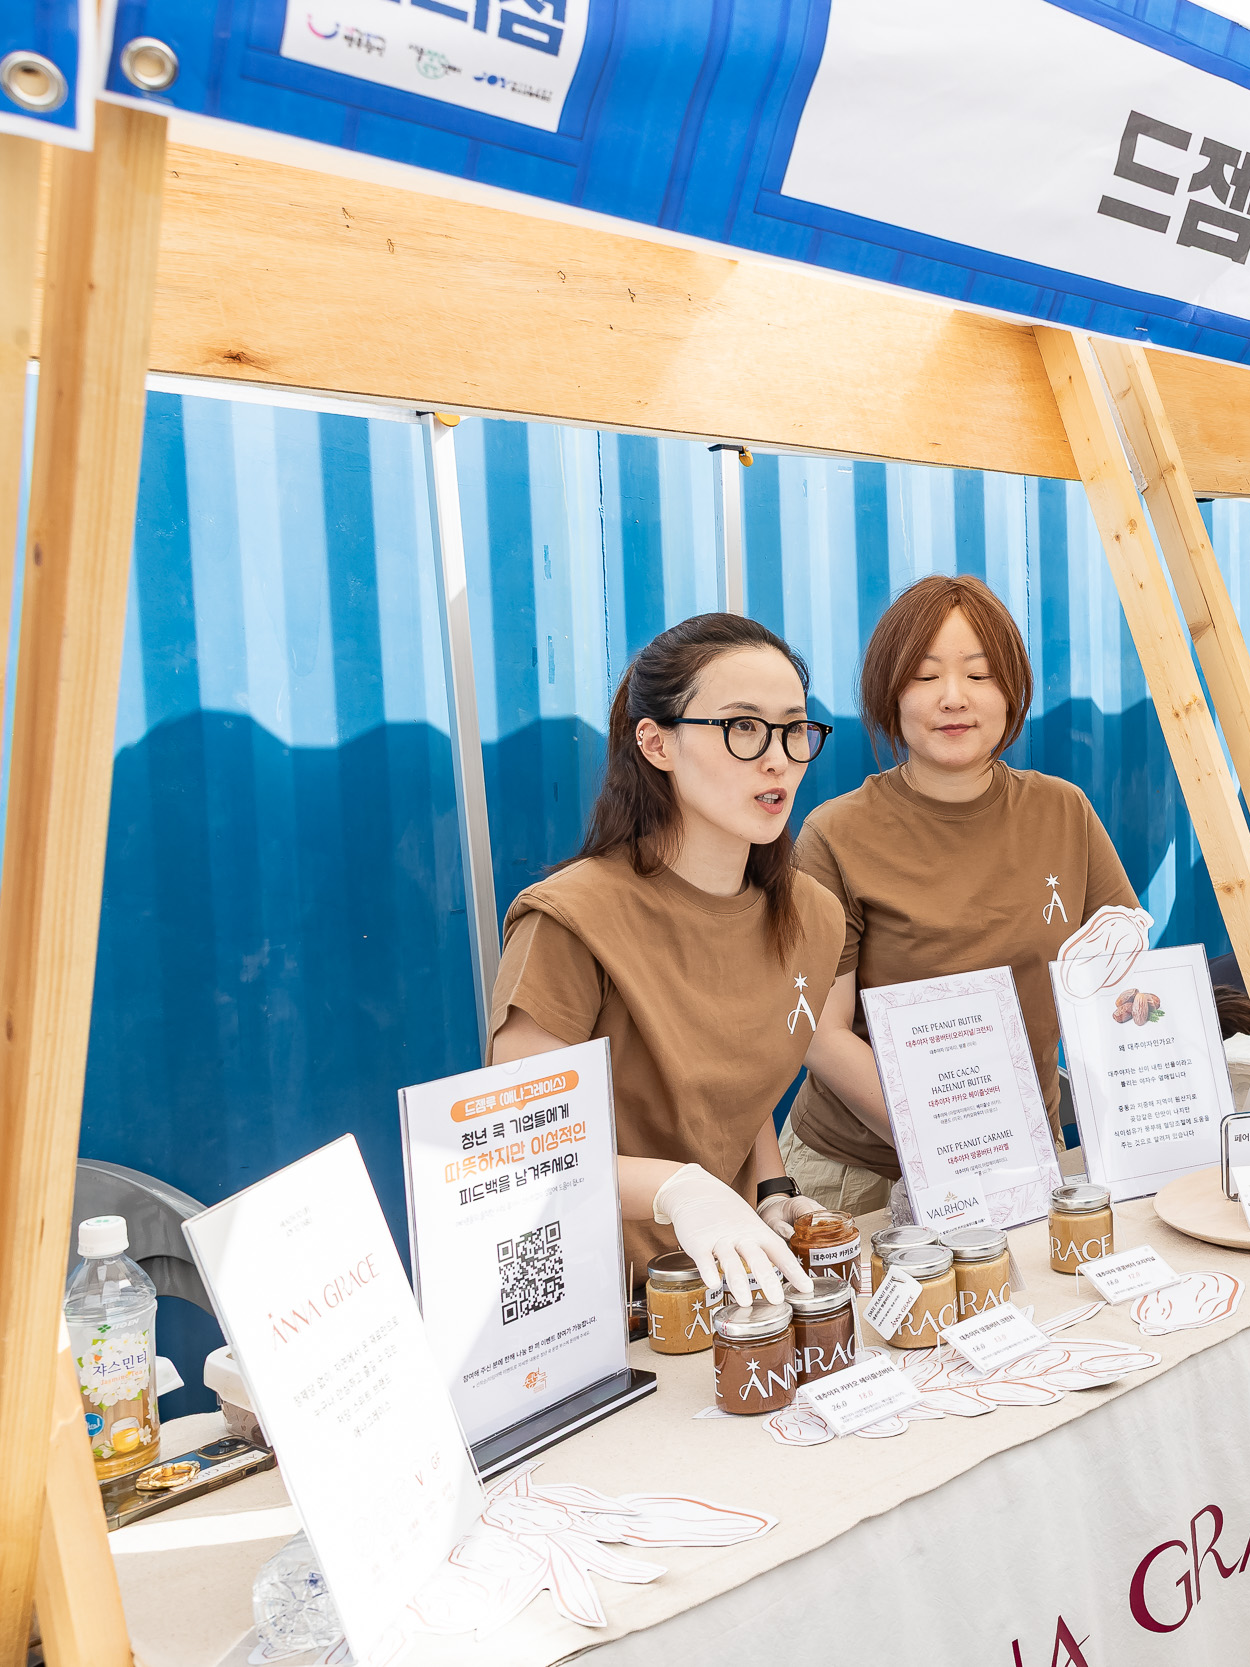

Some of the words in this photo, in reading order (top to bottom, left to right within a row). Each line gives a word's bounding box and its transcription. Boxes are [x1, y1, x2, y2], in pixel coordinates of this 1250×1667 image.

[911, 1024, 929, 1036] DATE
[930, 1019, 956, 1032] PEANUT
[957, 1014, 983, 1027] BUTTER
[905, 1038, 929, 1048] 대추야자
[1127, 1037, 1175, 1051] 대추야자인가요?
[938, 1070, 955, 1082] DATE
[956, 1065, 980, 1078] CACAO
[1108, 1068, 1136, 1078] 대추야자는
[1164, 1058, 1193, 1069] 선물이라고
[1158, 1071, 1186, 1081] 열매입니다
[931, 1080, 966, 1095] HAZELNUT
[966, 1074, 992, 1087] BUTTER
[465, 1095, 496, 1117] 드젬루
[499, 1076, 567, 1106] (애나그레이스)
[928, 1097, 951, 1108] 대추야자
[951, 1093, 967, 1103] 카카오
[462, 1127, 488, 1150] 청년
[492, 1122, 505, 1139] 쿡
[510, 1103, 570, 1134] 기업들에게
[445, 1140, 526, 1184] 따뜻하지만
[531, 1120, 587, 1156] 이성적인
[936, 1143, 954, 1156] DATE
[954, 1136, 981, 1150] PEANUT
[982, 1129, 1014, 1144] CARAMEL
[947, 1153, 970, 1165] 대추야자
[459, 1174, 511, 1206] 피드백을
[515, 1152, 579, 1187] 남겨주세요!
[926, 1197, 979, 1220] VALRHONA
[812, 1251, 838, 1261] 대추야자
[839, 1247, 854, 1258] 카카오
[268, 1299, 322, 1351] ANNA
[323, 1252, 380, 1309] GRACE
[111, 1320, 127, 1331] ITO
[127, 1318, 140, 1327] EN
[540, 1334, 556, 1346] 이벤트
[556, 1327, 572, 1340] 참여가
[100, 1373, 129, 1386] Jasmine
[130, 1369, 143, 1378] Tea
[814, 1387, 840, 1401] 대추야자
[840, 1379, 860, 1391] 카카오
[832, 1400, 848, 1412] 26.0
